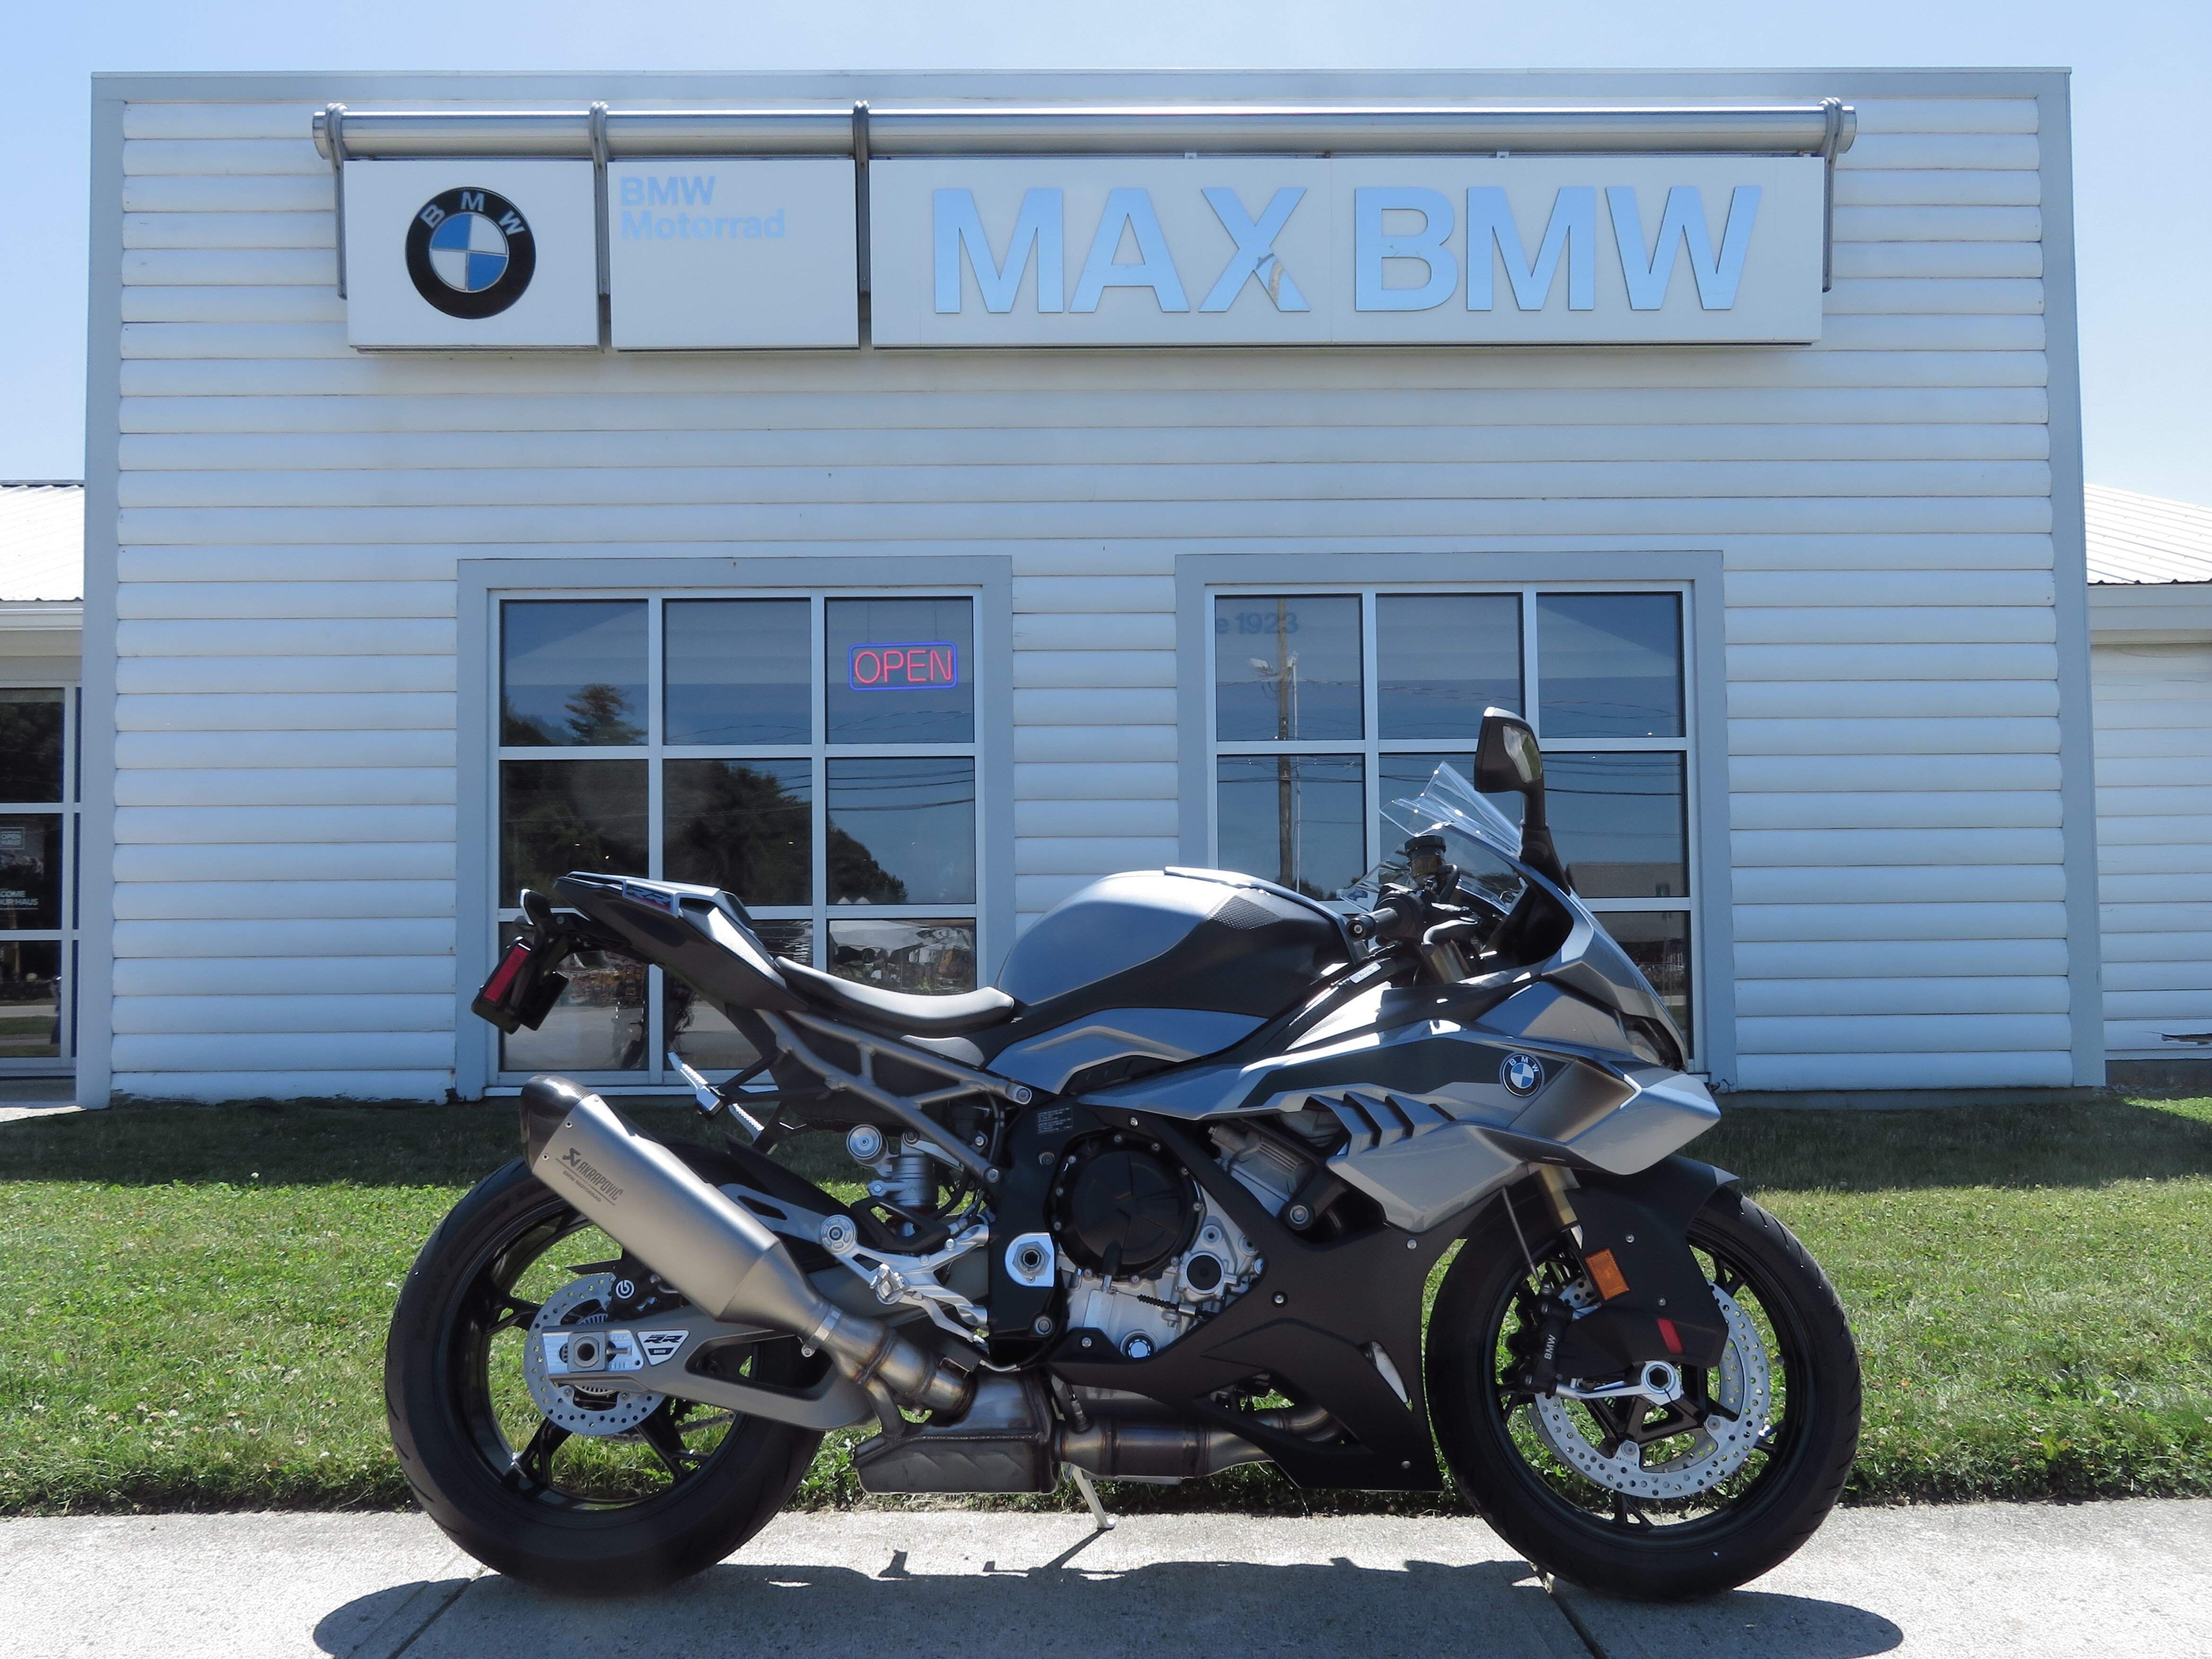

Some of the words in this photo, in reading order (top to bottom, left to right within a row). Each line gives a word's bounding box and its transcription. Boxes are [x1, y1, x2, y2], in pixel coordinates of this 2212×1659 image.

[621, 176, 716, 206] BMW
[419, 191, 526, 236] BMW
[621, 208, 786, 239] Motorrad
[933, 186, 1311, 314] MAX
[1354, 185, 1762, 312] BMW
[854, 649, 953, 684] OPEN
[1508, 1056, 1539, 1072] BMW
[575, 1179, 602, 1202] MOTORRAD
[1544, 1334, 1556, 1360] BMW
